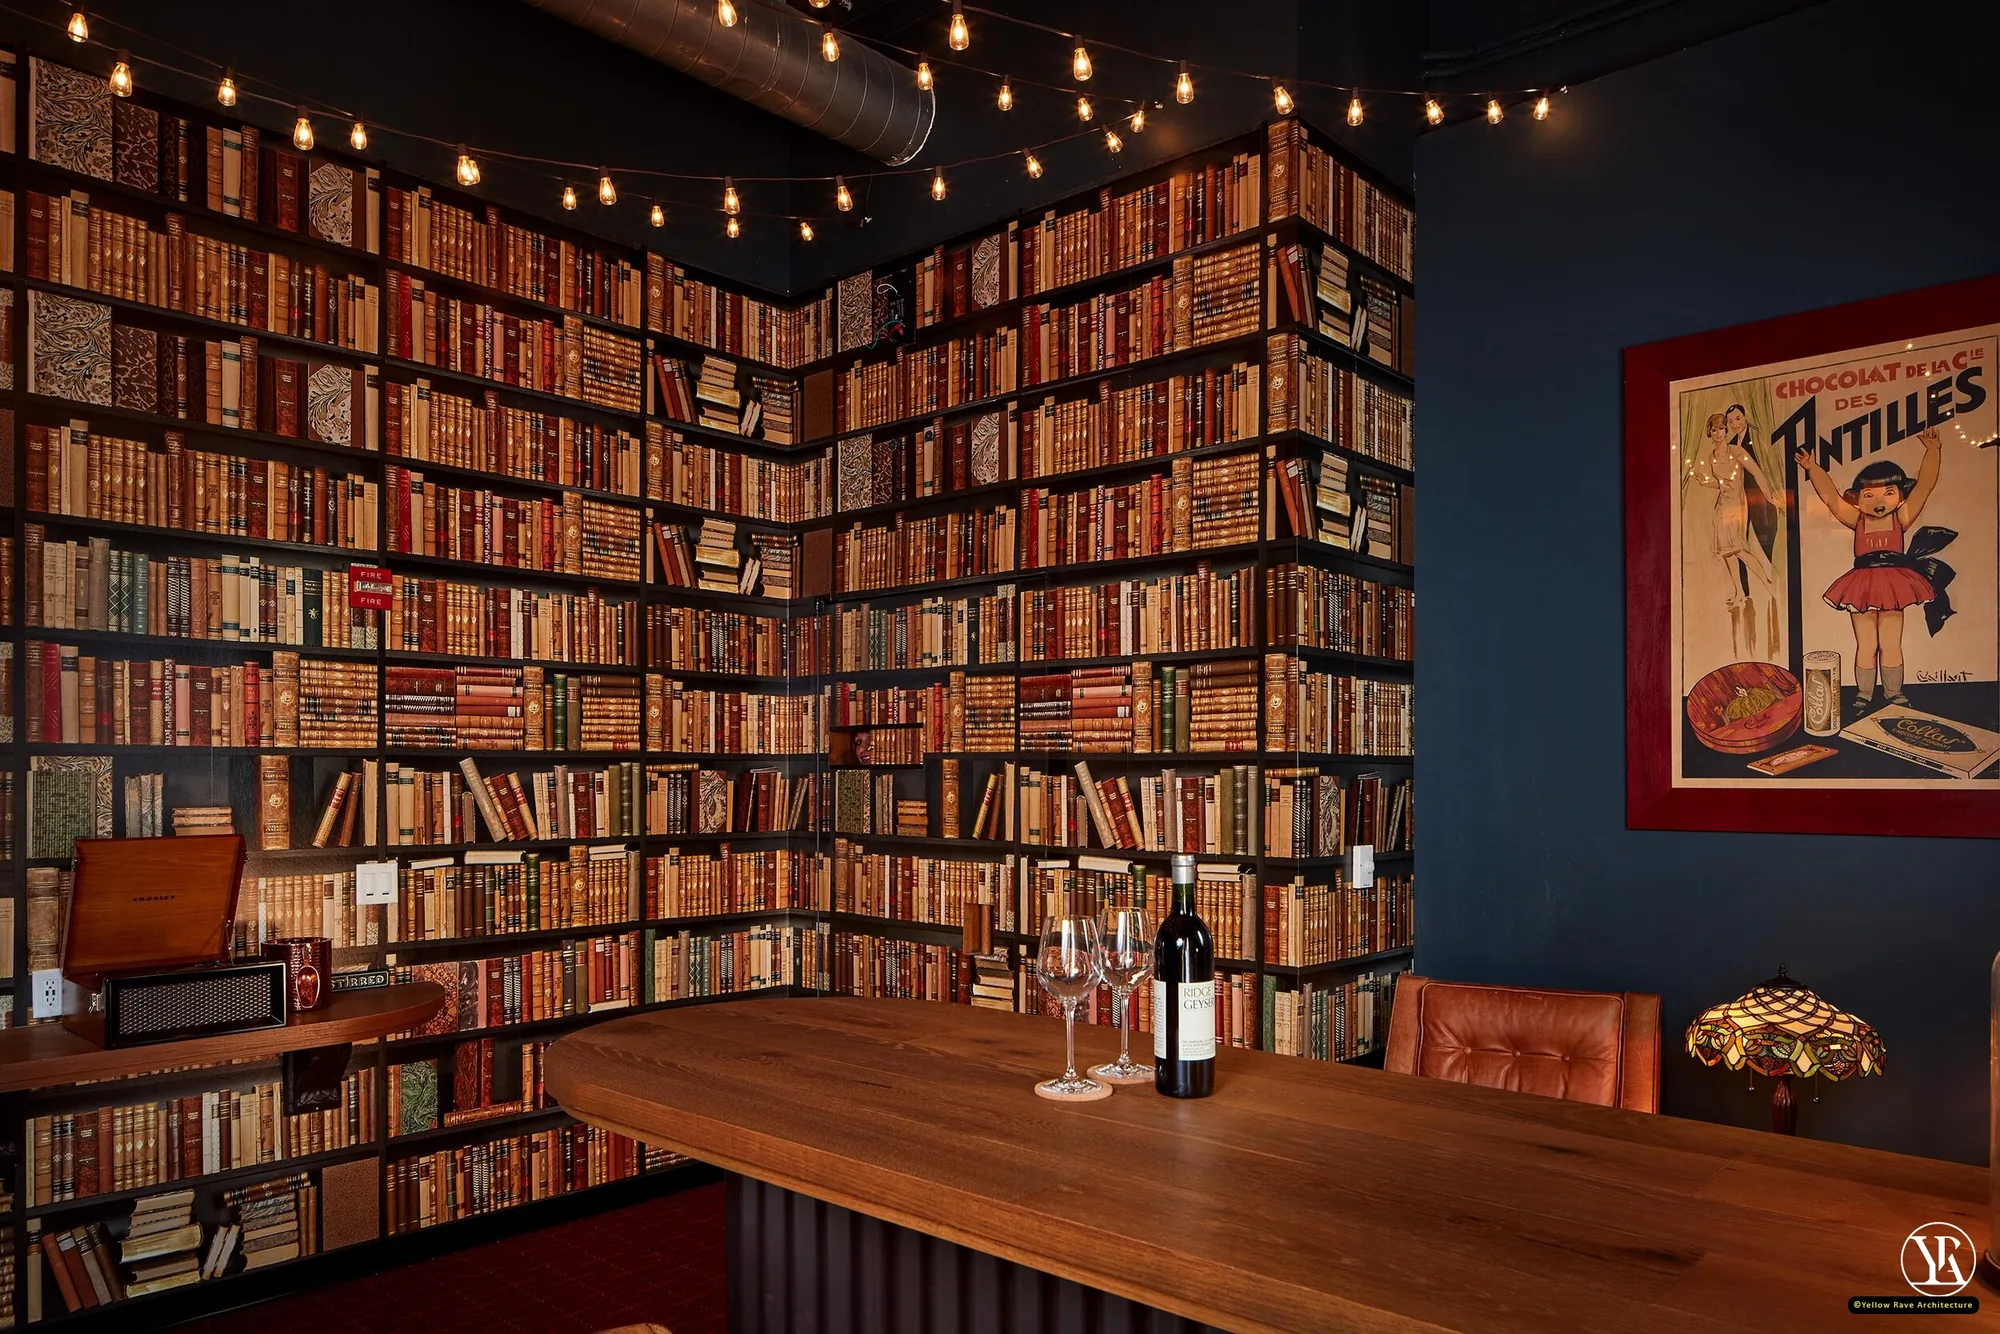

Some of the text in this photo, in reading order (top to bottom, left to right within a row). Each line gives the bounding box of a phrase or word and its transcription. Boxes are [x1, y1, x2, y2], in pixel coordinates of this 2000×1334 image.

[1775, 362, 1901, 399] CHOCOLAT
[1905, 363, 1927, 379] DE
[1931, 359, 1951, 374] LA
[1835, 393, 1879, 411] DES
[1771, 366, 1987, 478] ANTILLES
[360, 571, 382, 580] FIRE
[360, 597, 382, 606] FIRE
[1183, 986, 1212, 998] RIDGE
